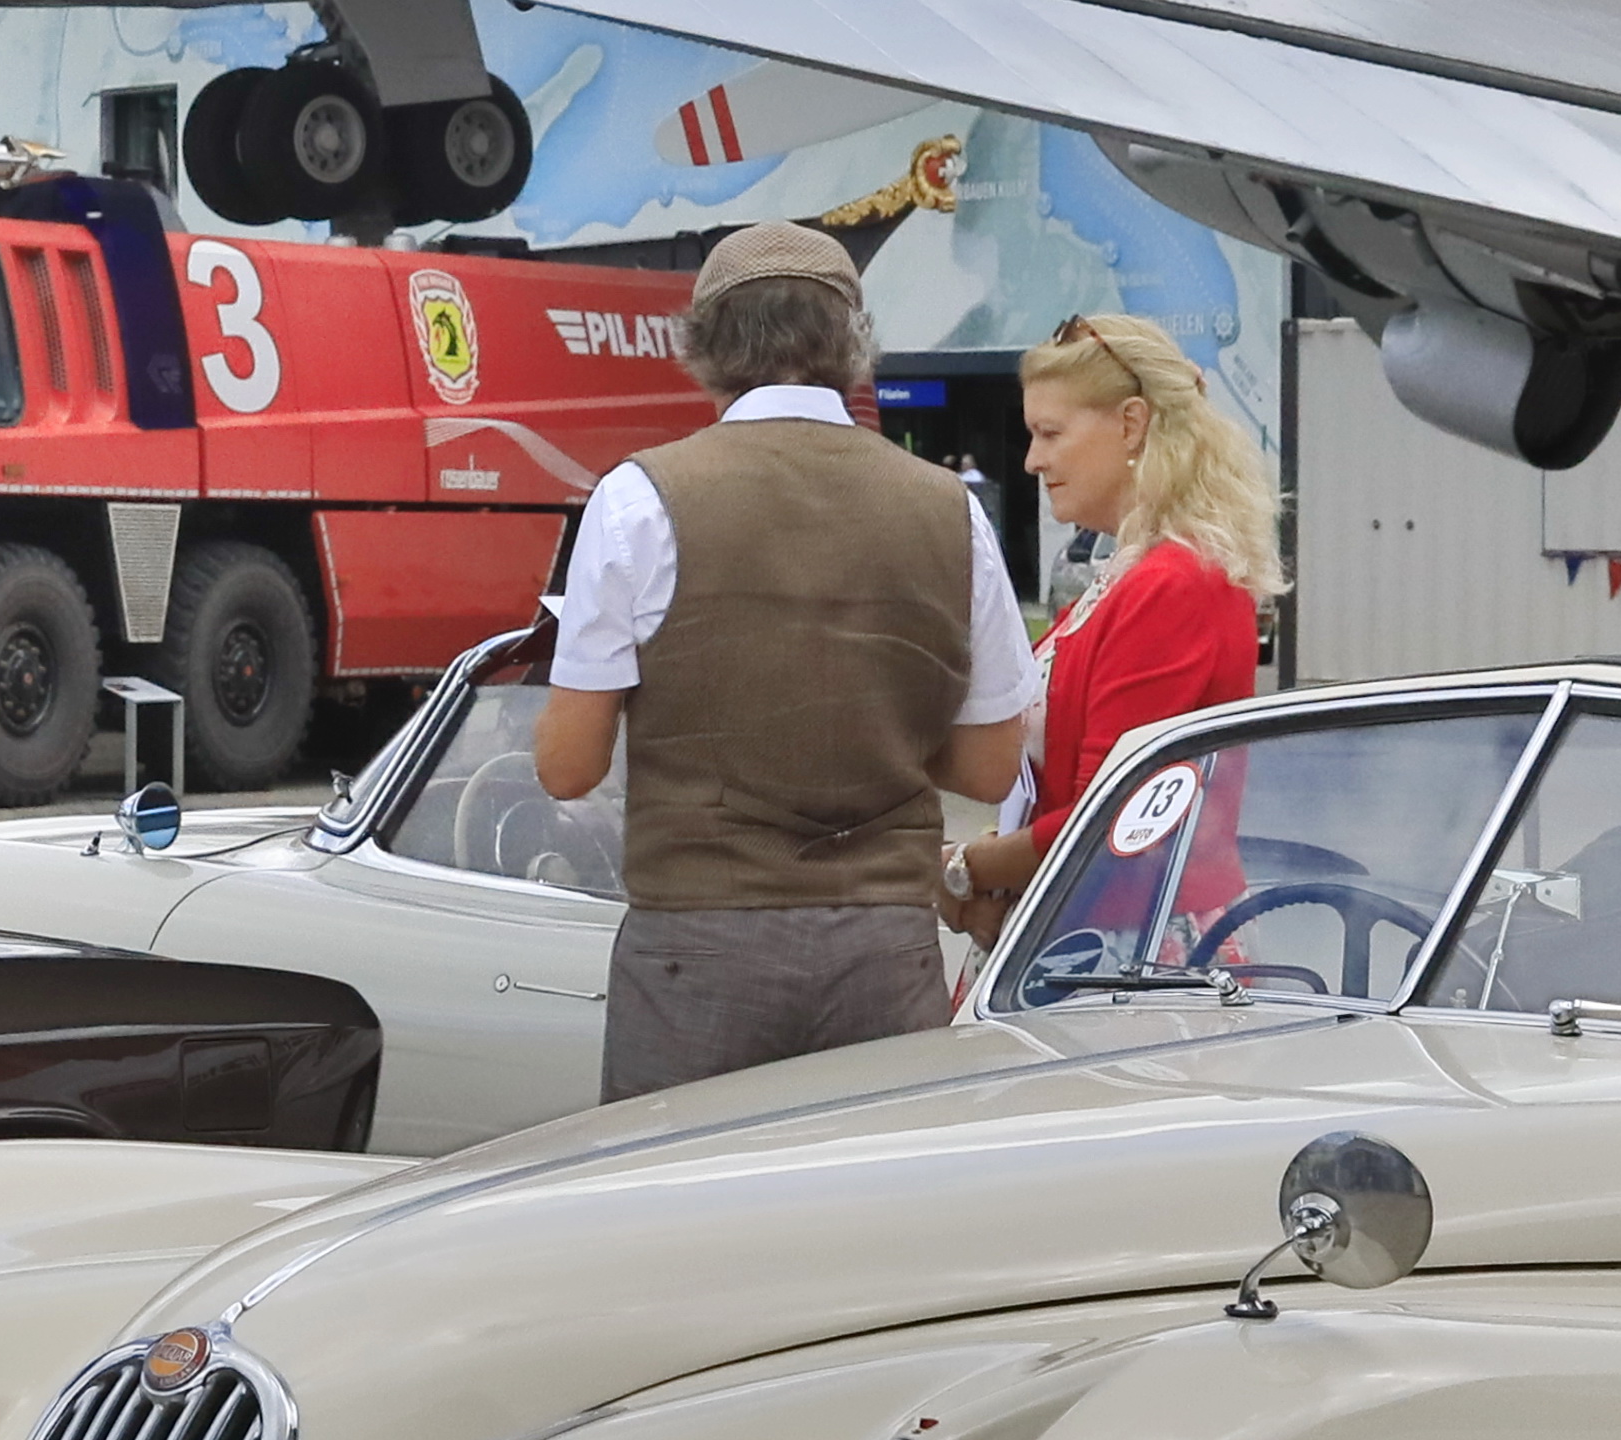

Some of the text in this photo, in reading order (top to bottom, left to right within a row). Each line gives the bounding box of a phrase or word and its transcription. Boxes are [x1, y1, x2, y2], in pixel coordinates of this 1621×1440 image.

[185, 238, 283, 414] 3
[584, 310, 687, 359] PILATU
[1139, 778, 1184, 819] 13
